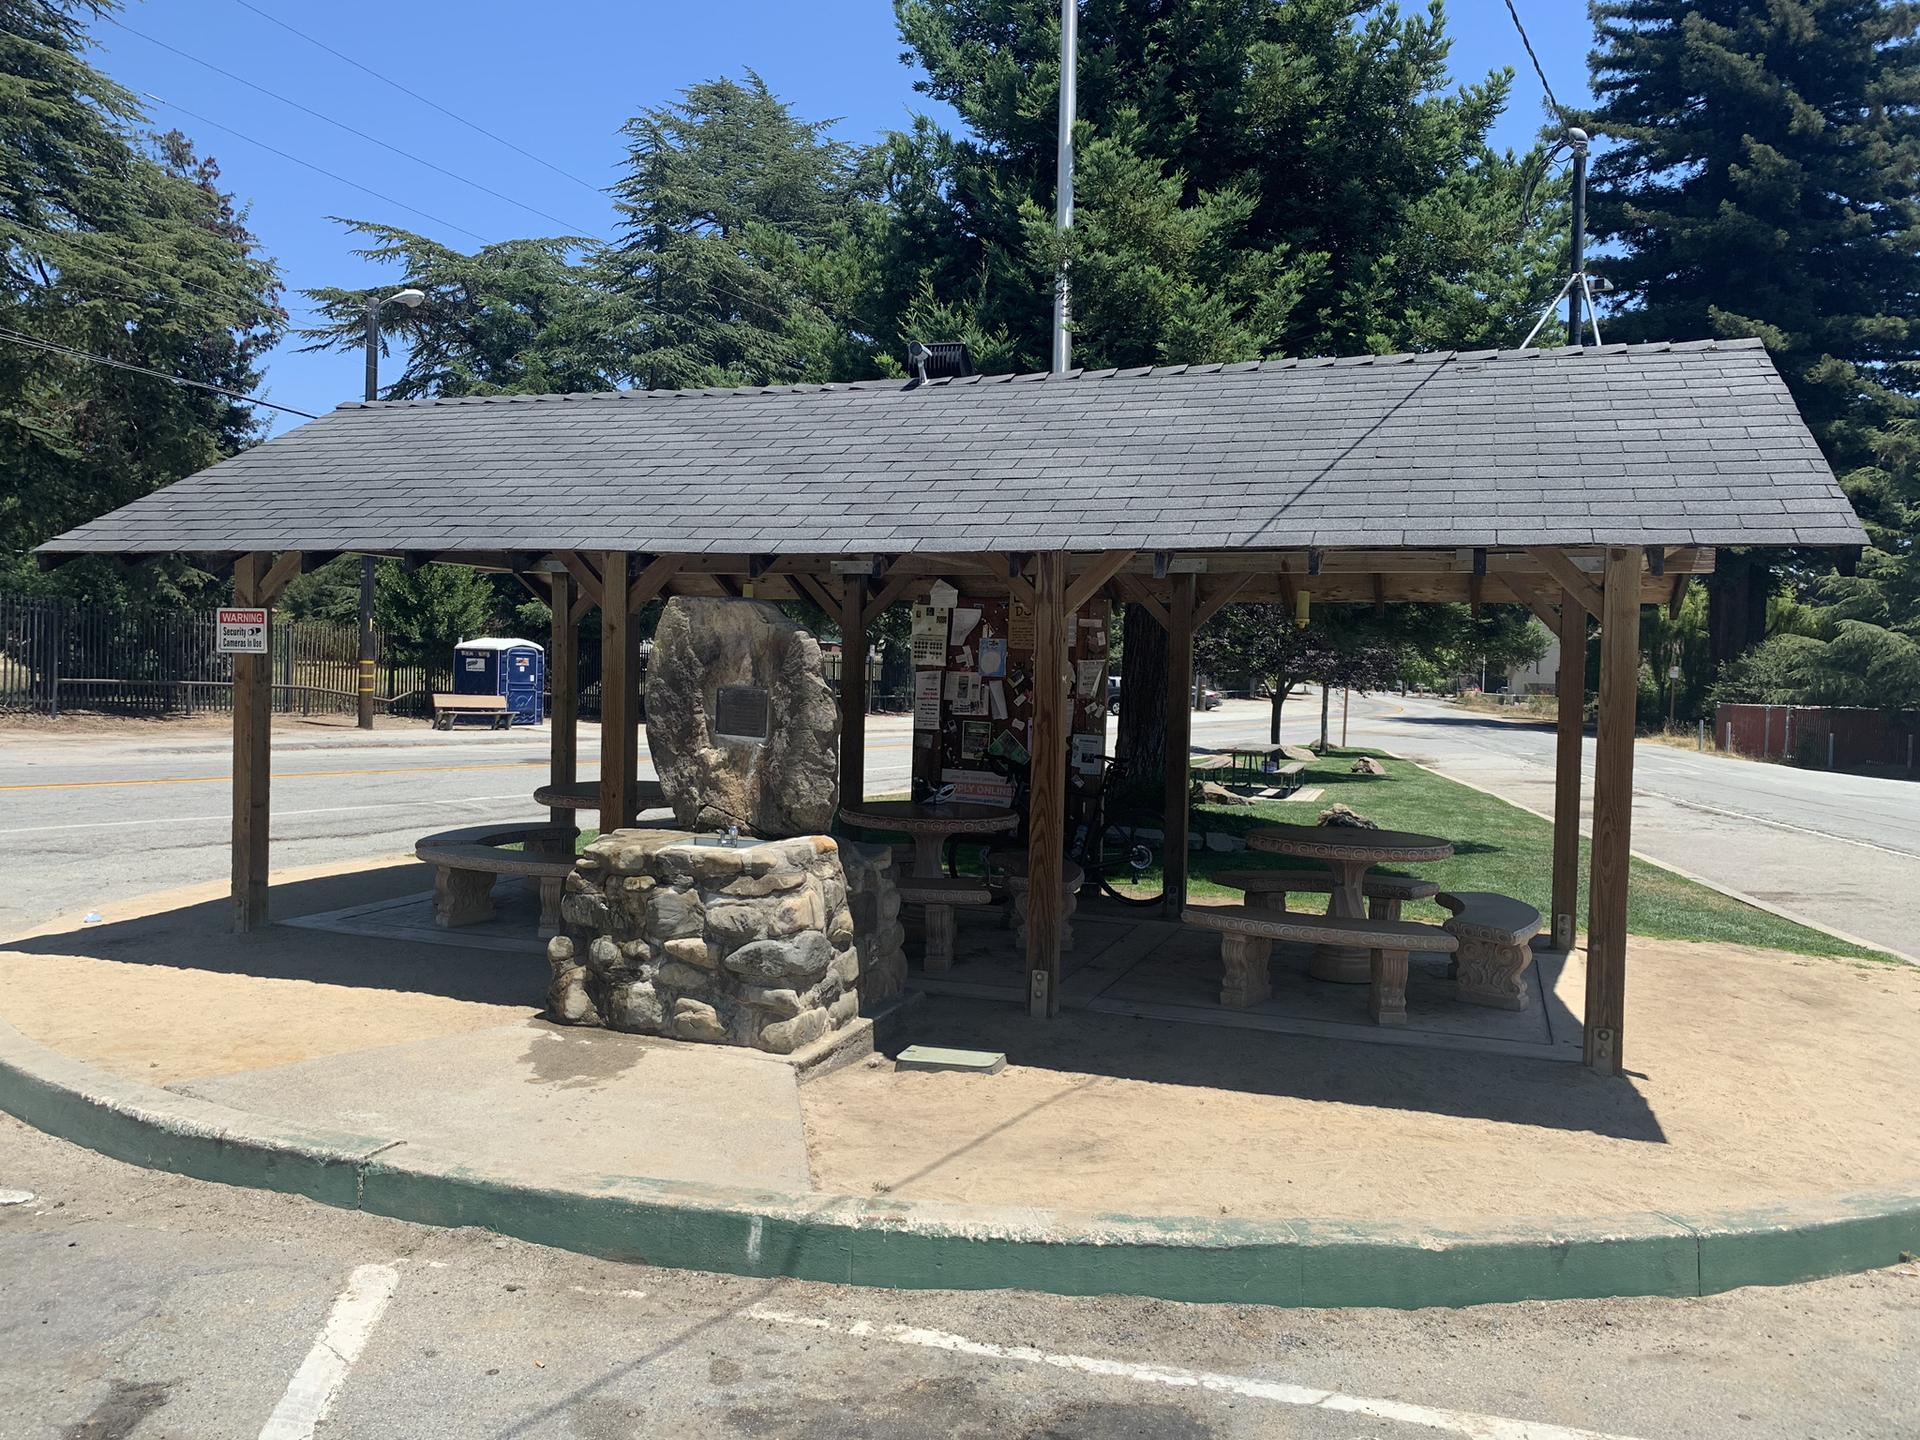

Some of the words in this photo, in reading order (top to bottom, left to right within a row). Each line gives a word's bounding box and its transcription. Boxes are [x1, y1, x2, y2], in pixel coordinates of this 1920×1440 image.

[222, 612, 263, 623] WARNING
[223, 626, 247, 638] Security
[223, 638, 246, 648] Cameras
[253, 638, 262, 648] Use
